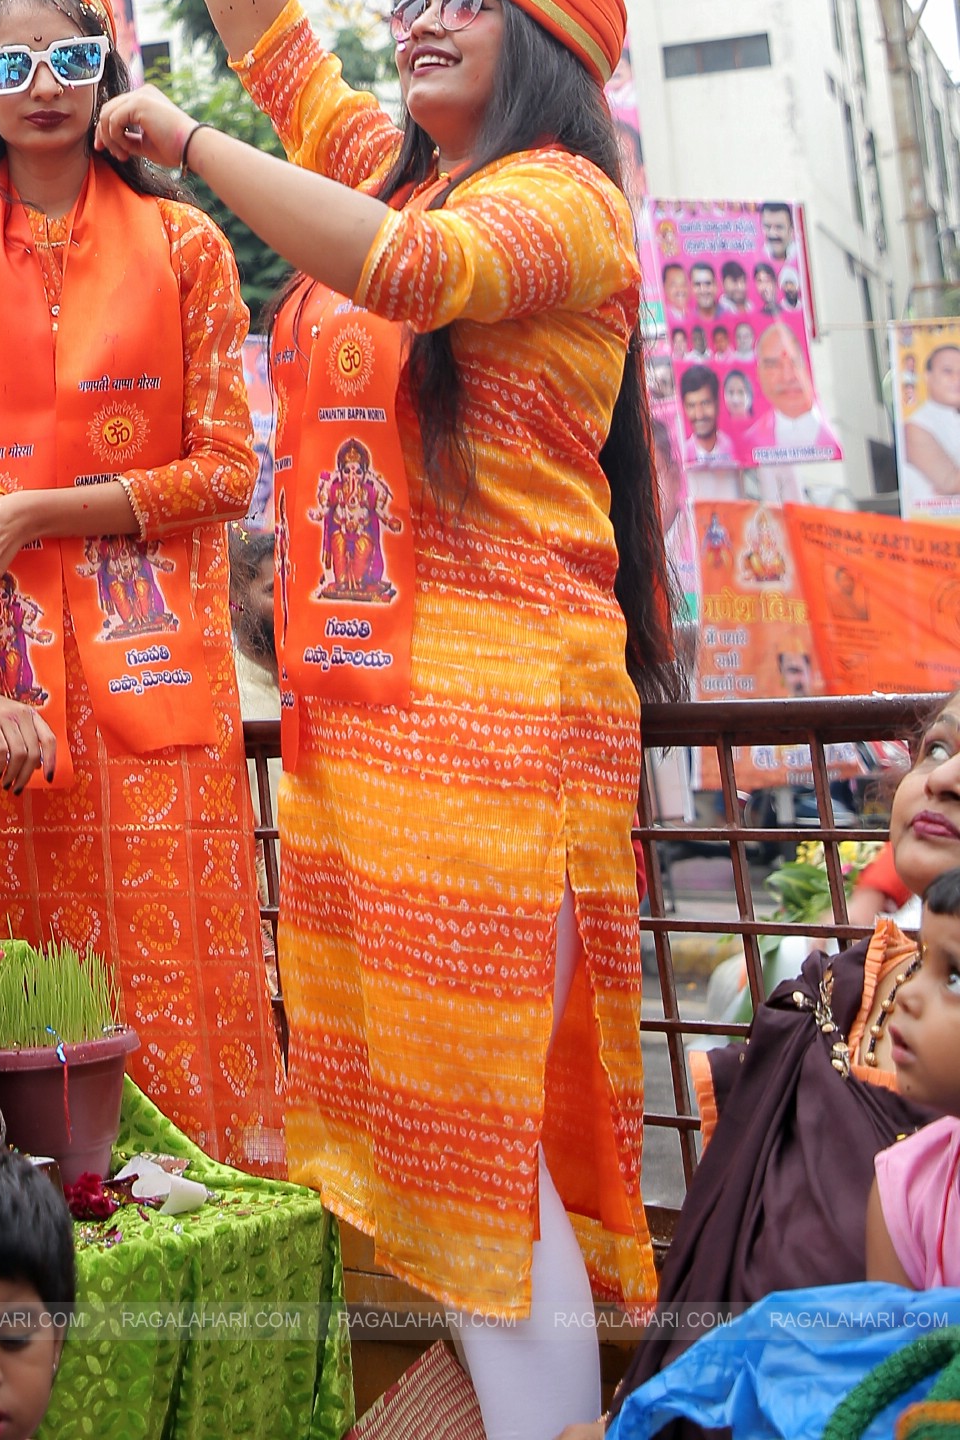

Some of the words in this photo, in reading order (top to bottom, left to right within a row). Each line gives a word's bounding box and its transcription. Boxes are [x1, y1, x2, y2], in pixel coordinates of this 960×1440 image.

[319, 408, 346, 420] GANAPATHI
[347, 408, 366, 420] BAPPA
[75, 473, 111, 487] GANAPATHI
[326, 618, 370, 638] గణపతి
[127, 646, 170, 666] గణపతి
